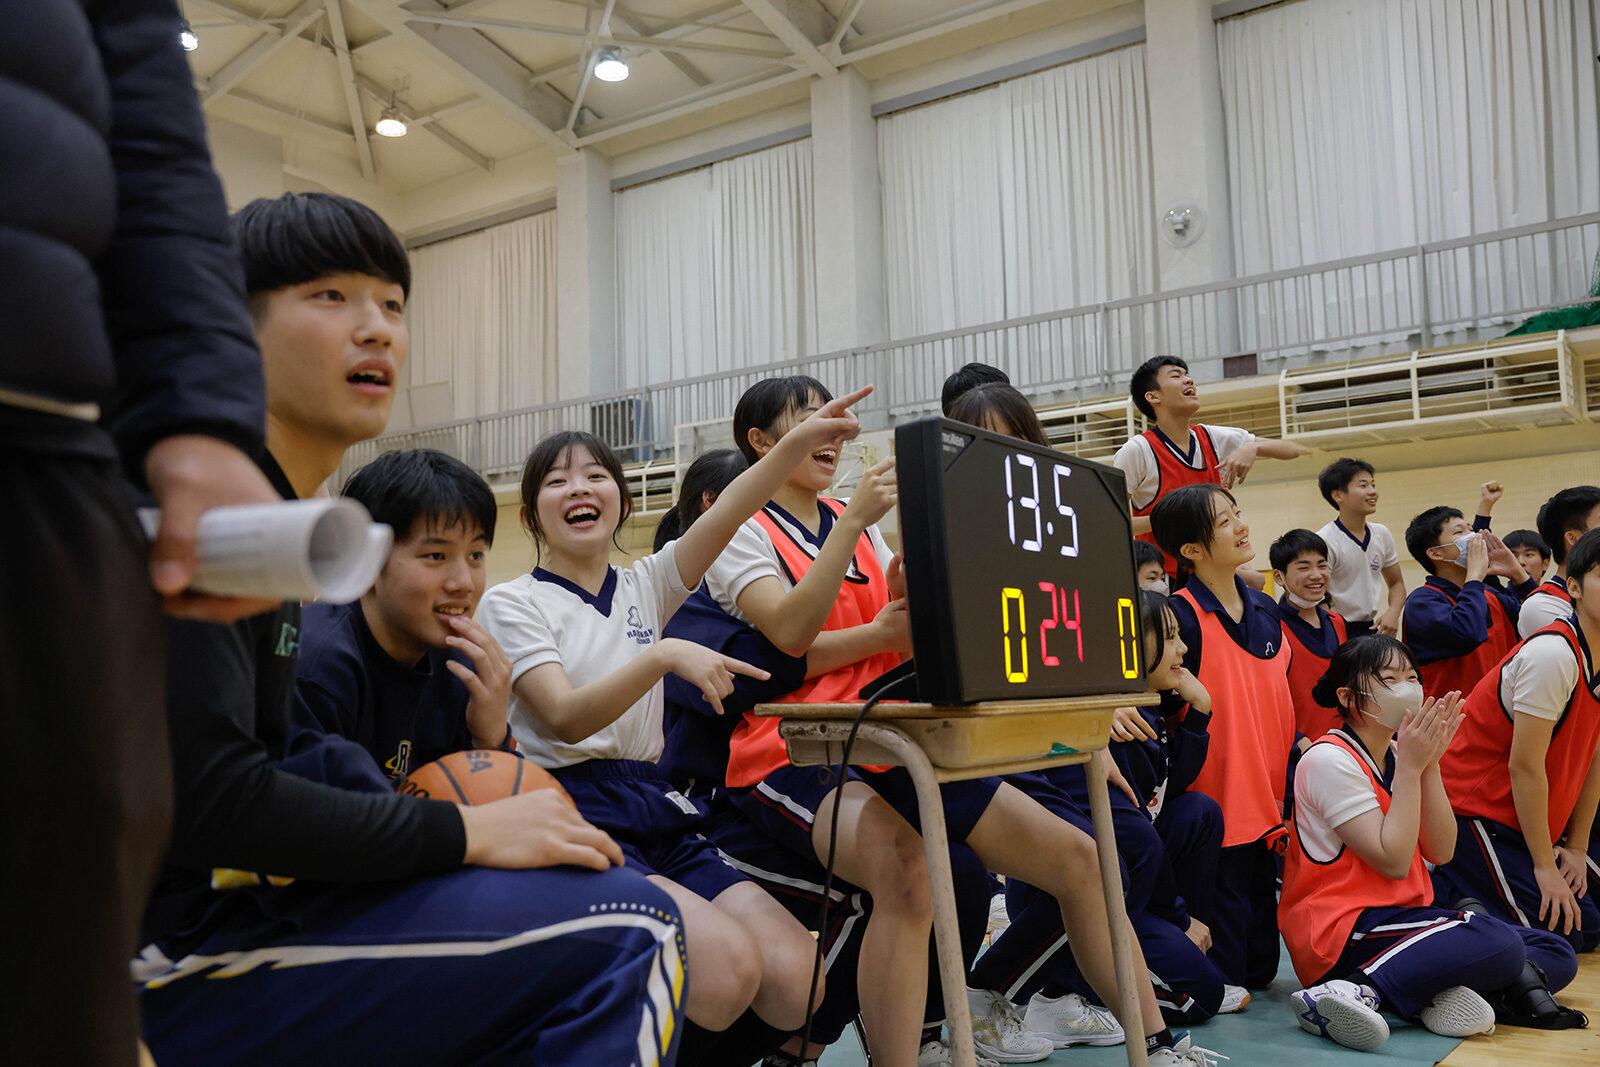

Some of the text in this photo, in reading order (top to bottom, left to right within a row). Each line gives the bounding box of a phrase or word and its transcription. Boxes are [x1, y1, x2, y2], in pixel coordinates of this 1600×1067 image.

[1004, 453, 1079, 557] 13.5
[1002, 581, 1139, 683] 0 24 0
